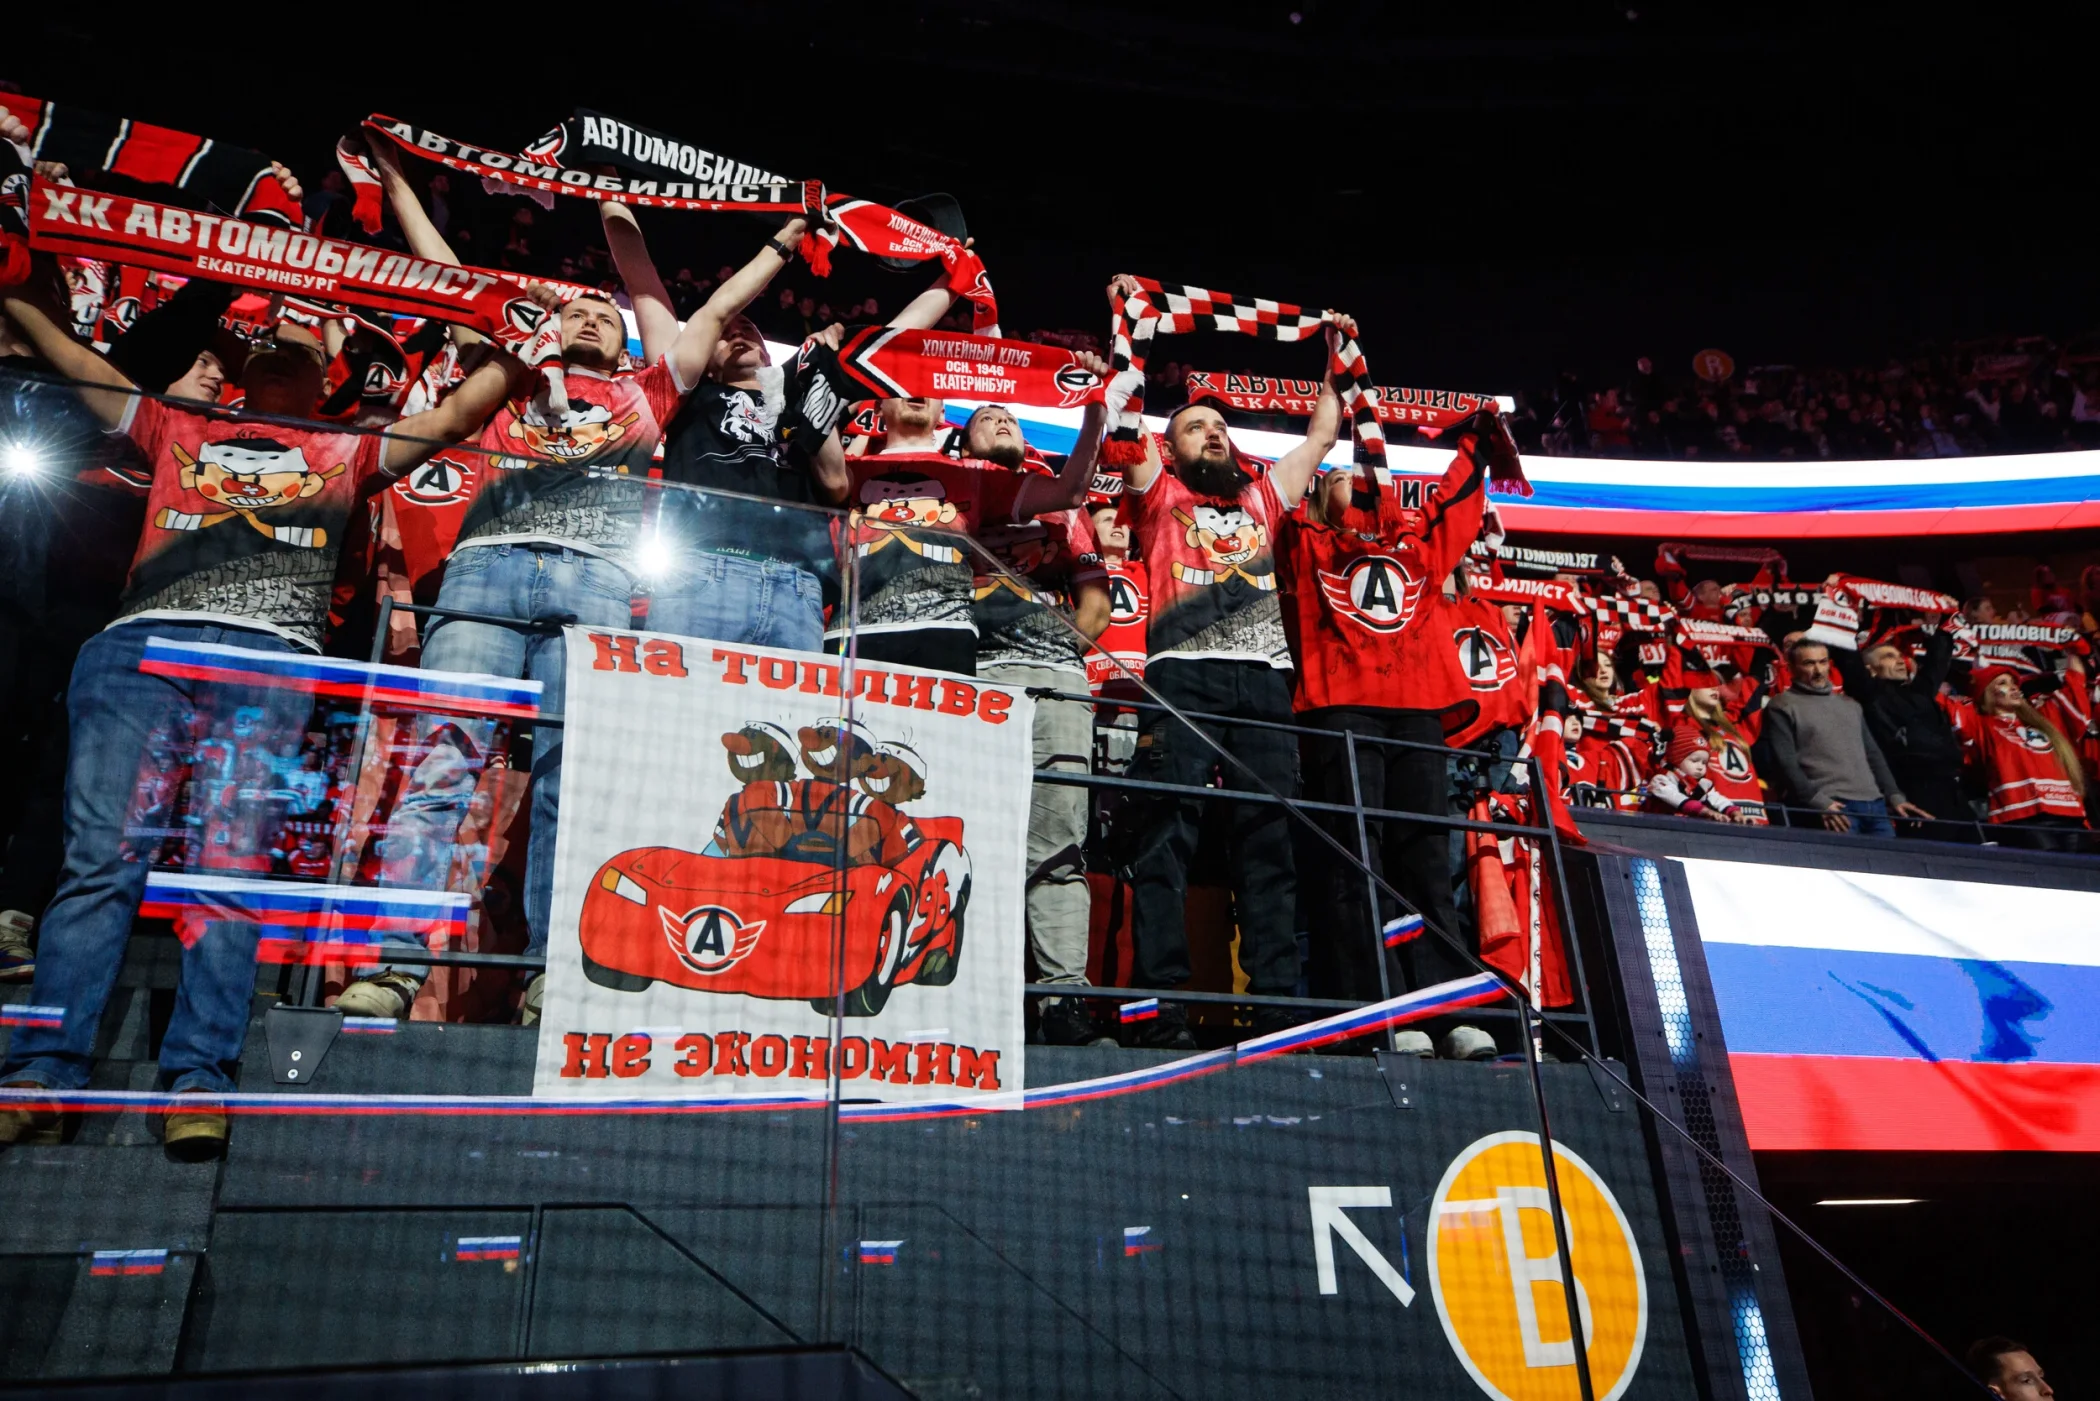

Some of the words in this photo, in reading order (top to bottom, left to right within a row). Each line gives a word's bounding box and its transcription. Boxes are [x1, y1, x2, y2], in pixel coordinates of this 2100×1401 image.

[383, 122, 788, 203] АВТОМОБИЛИСТ
[581, 115, 795, 185] АВТОМОБИЛИ
[441, 157, 724, 210] ЕКАТЕРИНБУРГ
[41, 187, 114, 232] ХК
[124, 203, 500, 302] АВТОМОБИЛИСТ
[195, 255, 338, 292] ЕКАТЕРИНБУРГ
[921, 338, 996, 362] ХОККЕЙНЫЙ
[998, 347, 1032, 368] КЛУБ
[945, 360, 973, 375] ОСН.
[976, 362, 1005, 377] 1946
[932, 372, 1017, 395] ЕКАТЕРИНБУРГ
[1496, 545, 1598, 569] AVTOMOBILIST
[711, 648, 1016, 725] топливе
[907, 868, 951, 948] 96
[673, 1030, 1003, 1091] экономим
